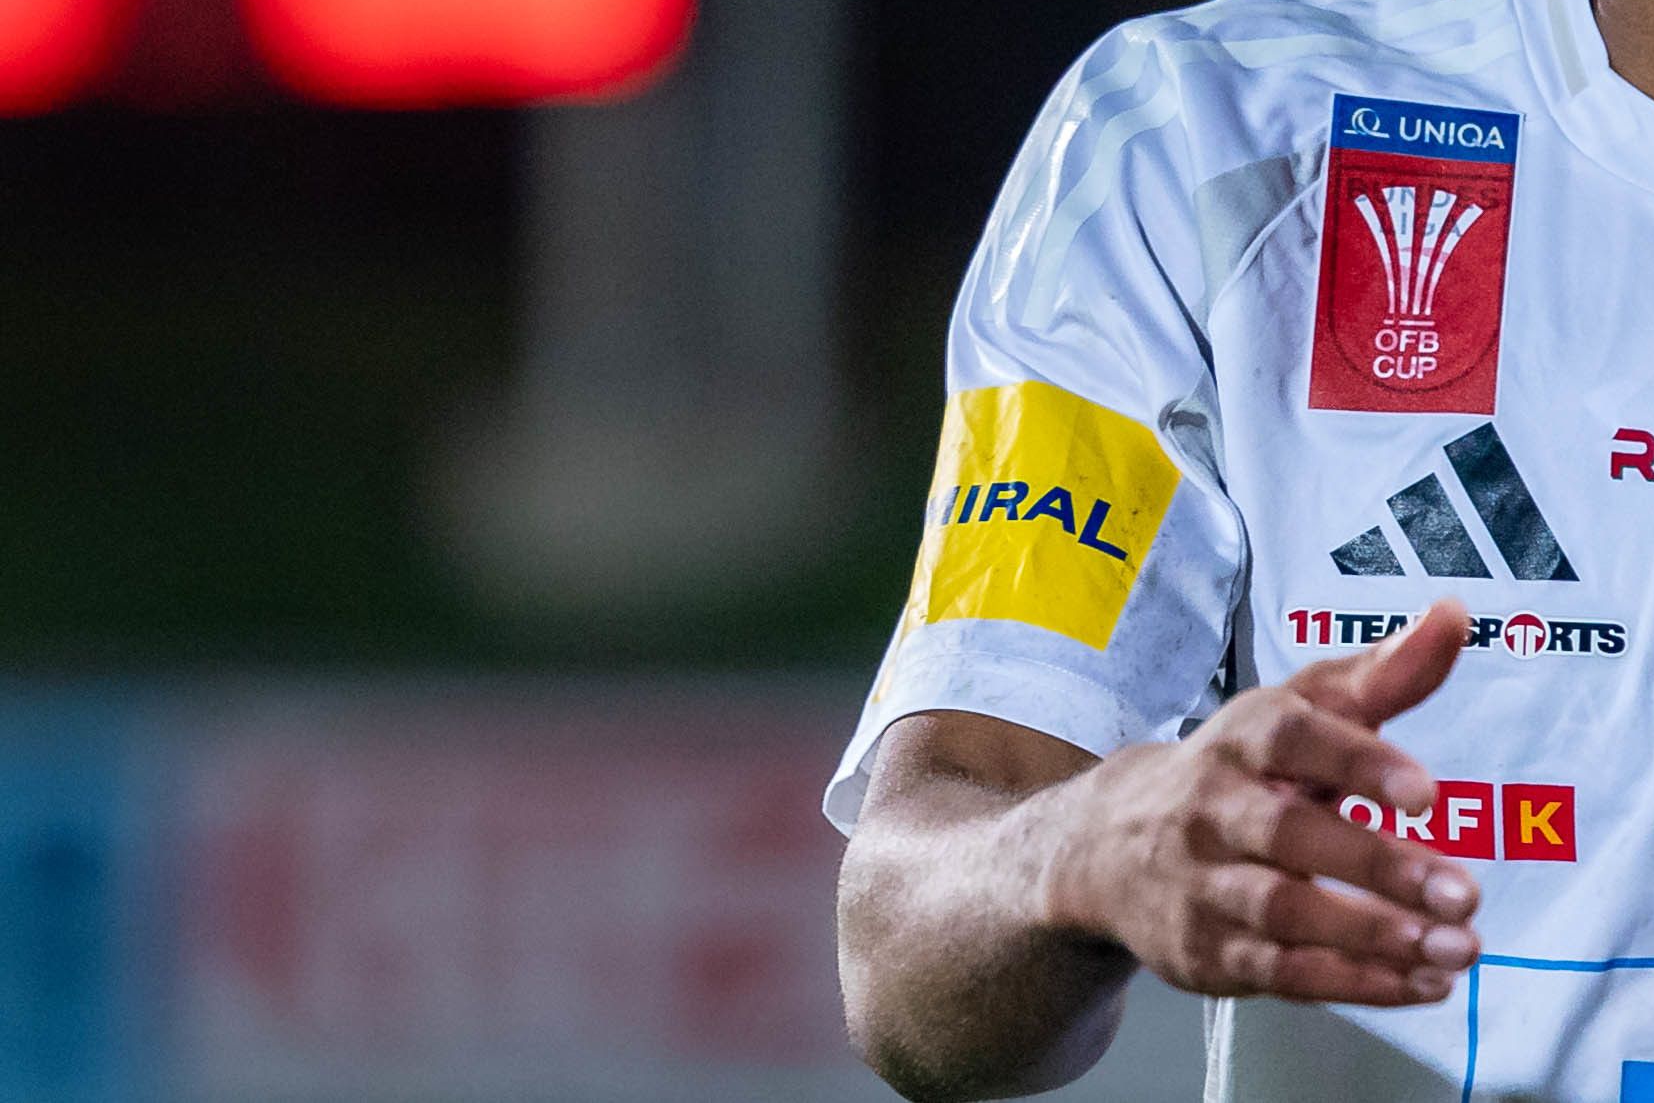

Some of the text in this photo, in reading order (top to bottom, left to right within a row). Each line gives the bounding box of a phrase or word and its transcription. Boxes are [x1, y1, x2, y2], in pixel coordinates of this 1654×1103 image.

[1399, 116, 1505, 150] UNIQA
[1372, 354, 1438, 379] CUP
[1339, 794, 1565, 845] ORF K
